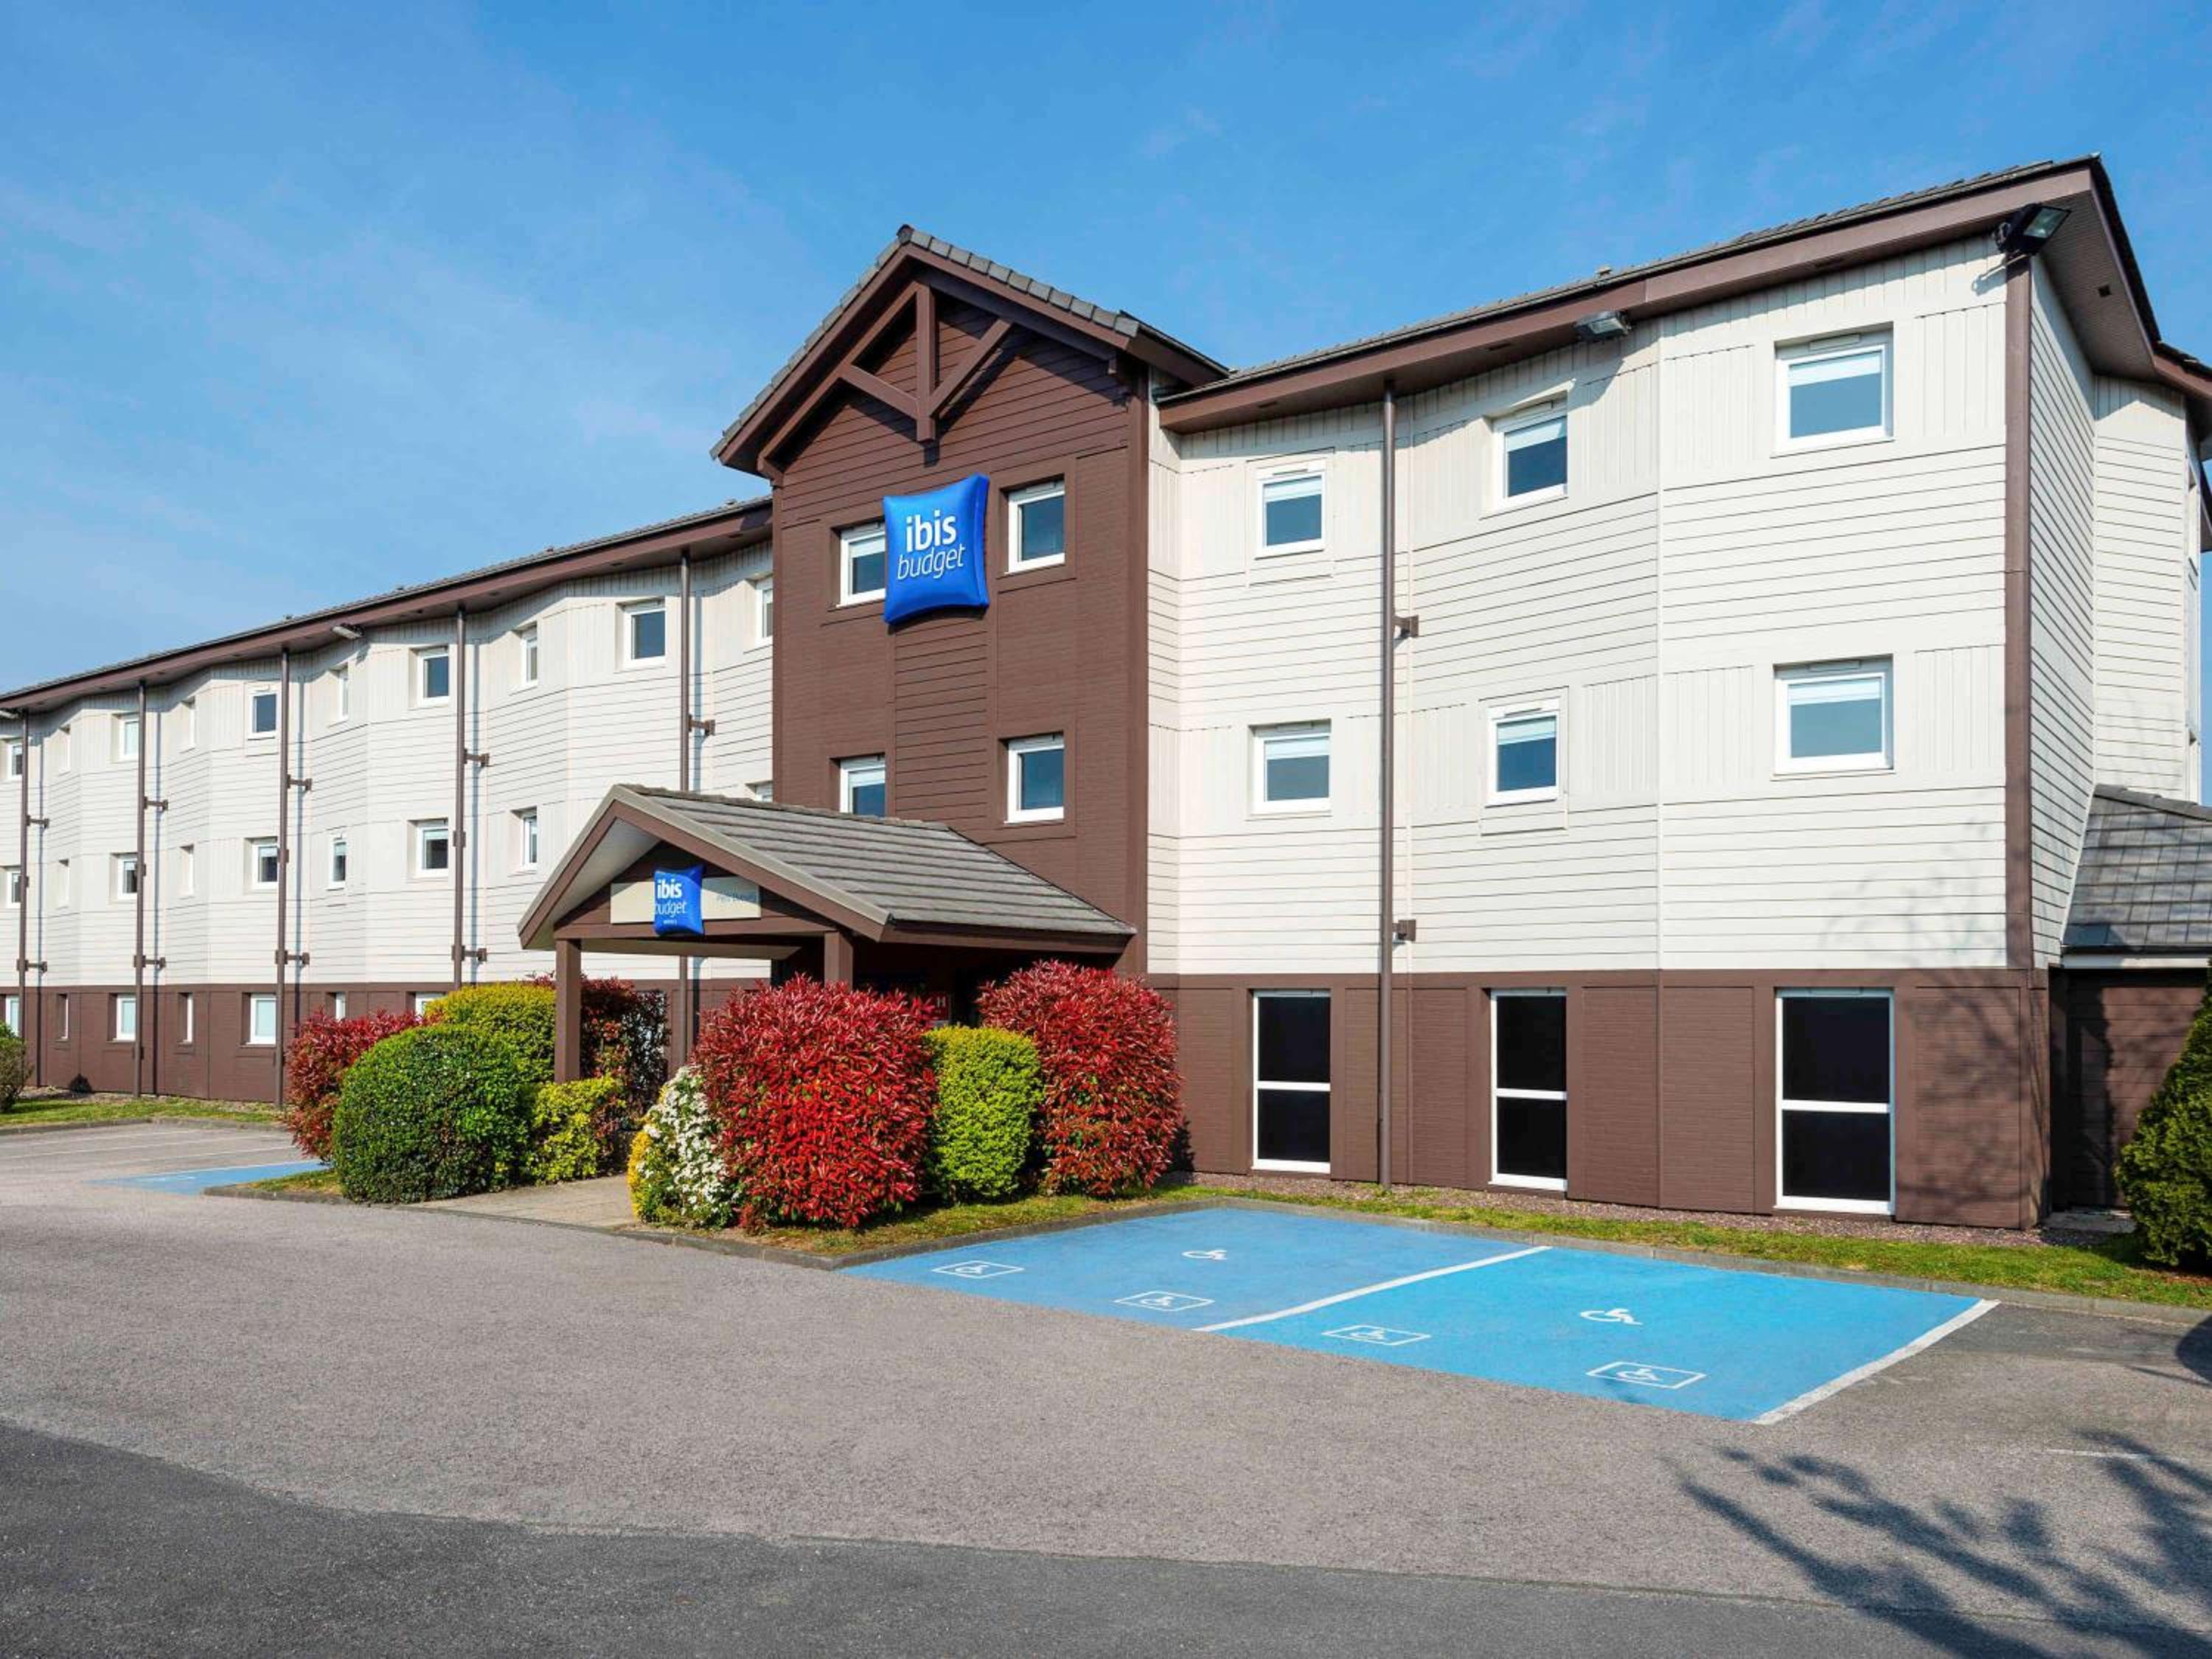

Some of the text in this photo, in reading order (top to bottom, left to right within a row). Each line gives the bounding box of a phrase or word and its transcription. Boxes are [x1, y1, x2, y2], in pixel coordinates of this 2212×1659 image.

[906, 509, 956, 552] ibis
[897, 543, 966, 580] budget
[657, 878, 682, 899] ibis
